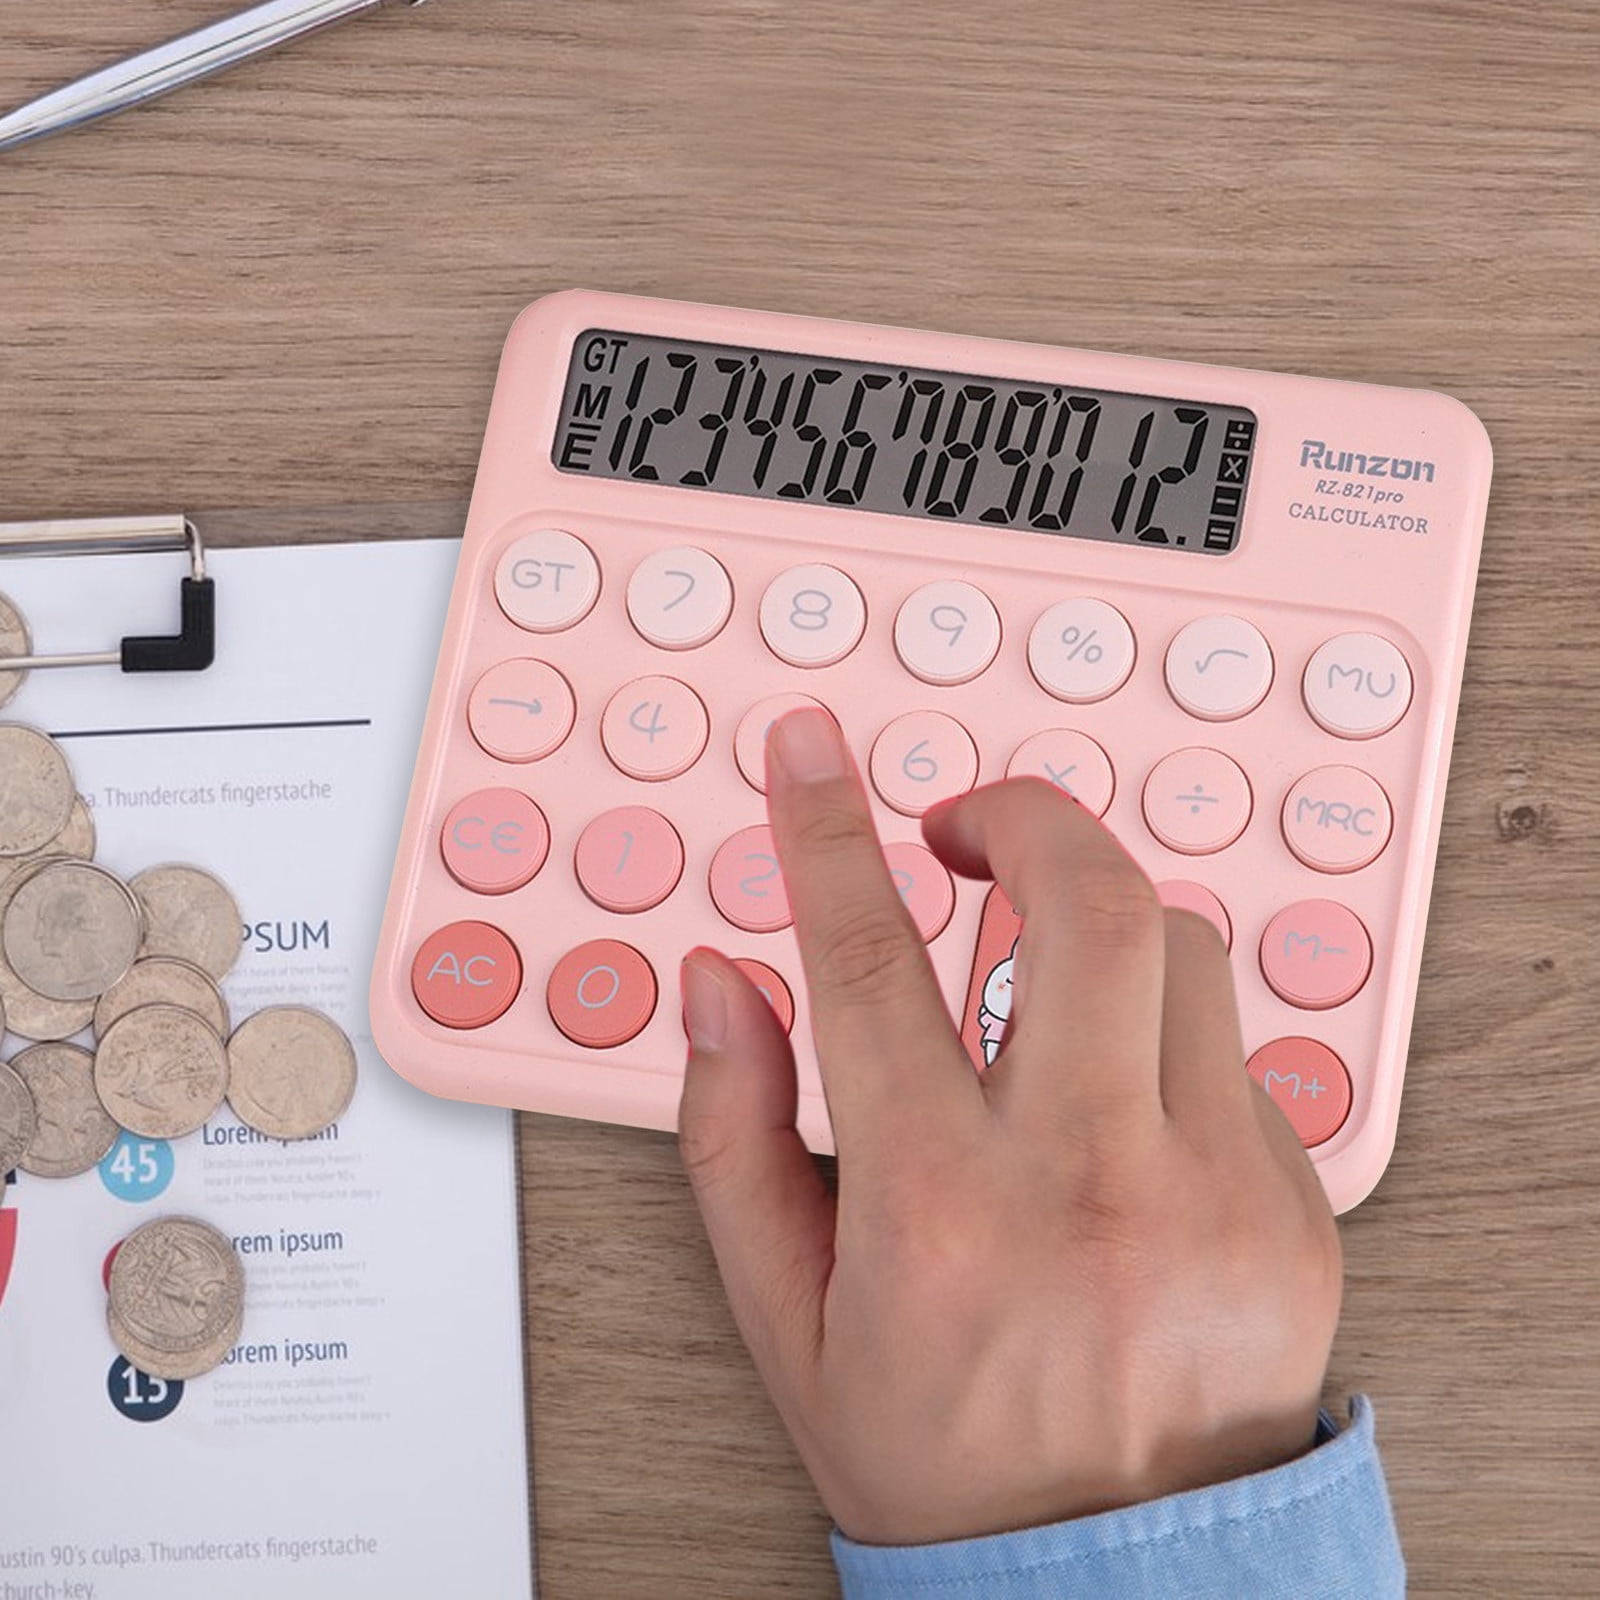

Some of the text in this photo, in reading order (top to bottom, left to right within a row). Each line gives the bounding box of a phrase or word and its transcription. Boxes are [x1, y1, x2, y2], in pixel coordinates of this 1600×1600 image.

[583, 337, 628, 374] GT
[572, 383, 612, 420] M
[559, 432, 597, 470] E
[1300, 439, 1435, 483] Runzon
[1289, 502, 1428, 534] CALCULATOR
[511, 559, 575, 592] GT
[663, 570, 696, 611] 7
[789, 590, 832, 631] 8
[929, 605, 968, 647] 9
[1327, 663, 1396, 699] MU
[629, 701, 668, 743] 4
[902, 740, 938, 782] 6
[105, 784, 216, 808] Thundercats
[221, 778, 333, 807] fingerstache
[452, 816, 525, 854] CE
[1295, 796, 1376, 836] MRC
[738, 853, 780, 897] 2
[427, 952, 496, 986] AC
[110, 1144, 159, 1184] 45
[232, 1228, 344, 1257] rem ipsum
[220, 1338, 348, 1367] orem ipsum
[121, 1364, 168, 1405] 15
[149, 1541, 261, 1564] Thundercats
[266, 1534, 378, 1562] fingerstache
